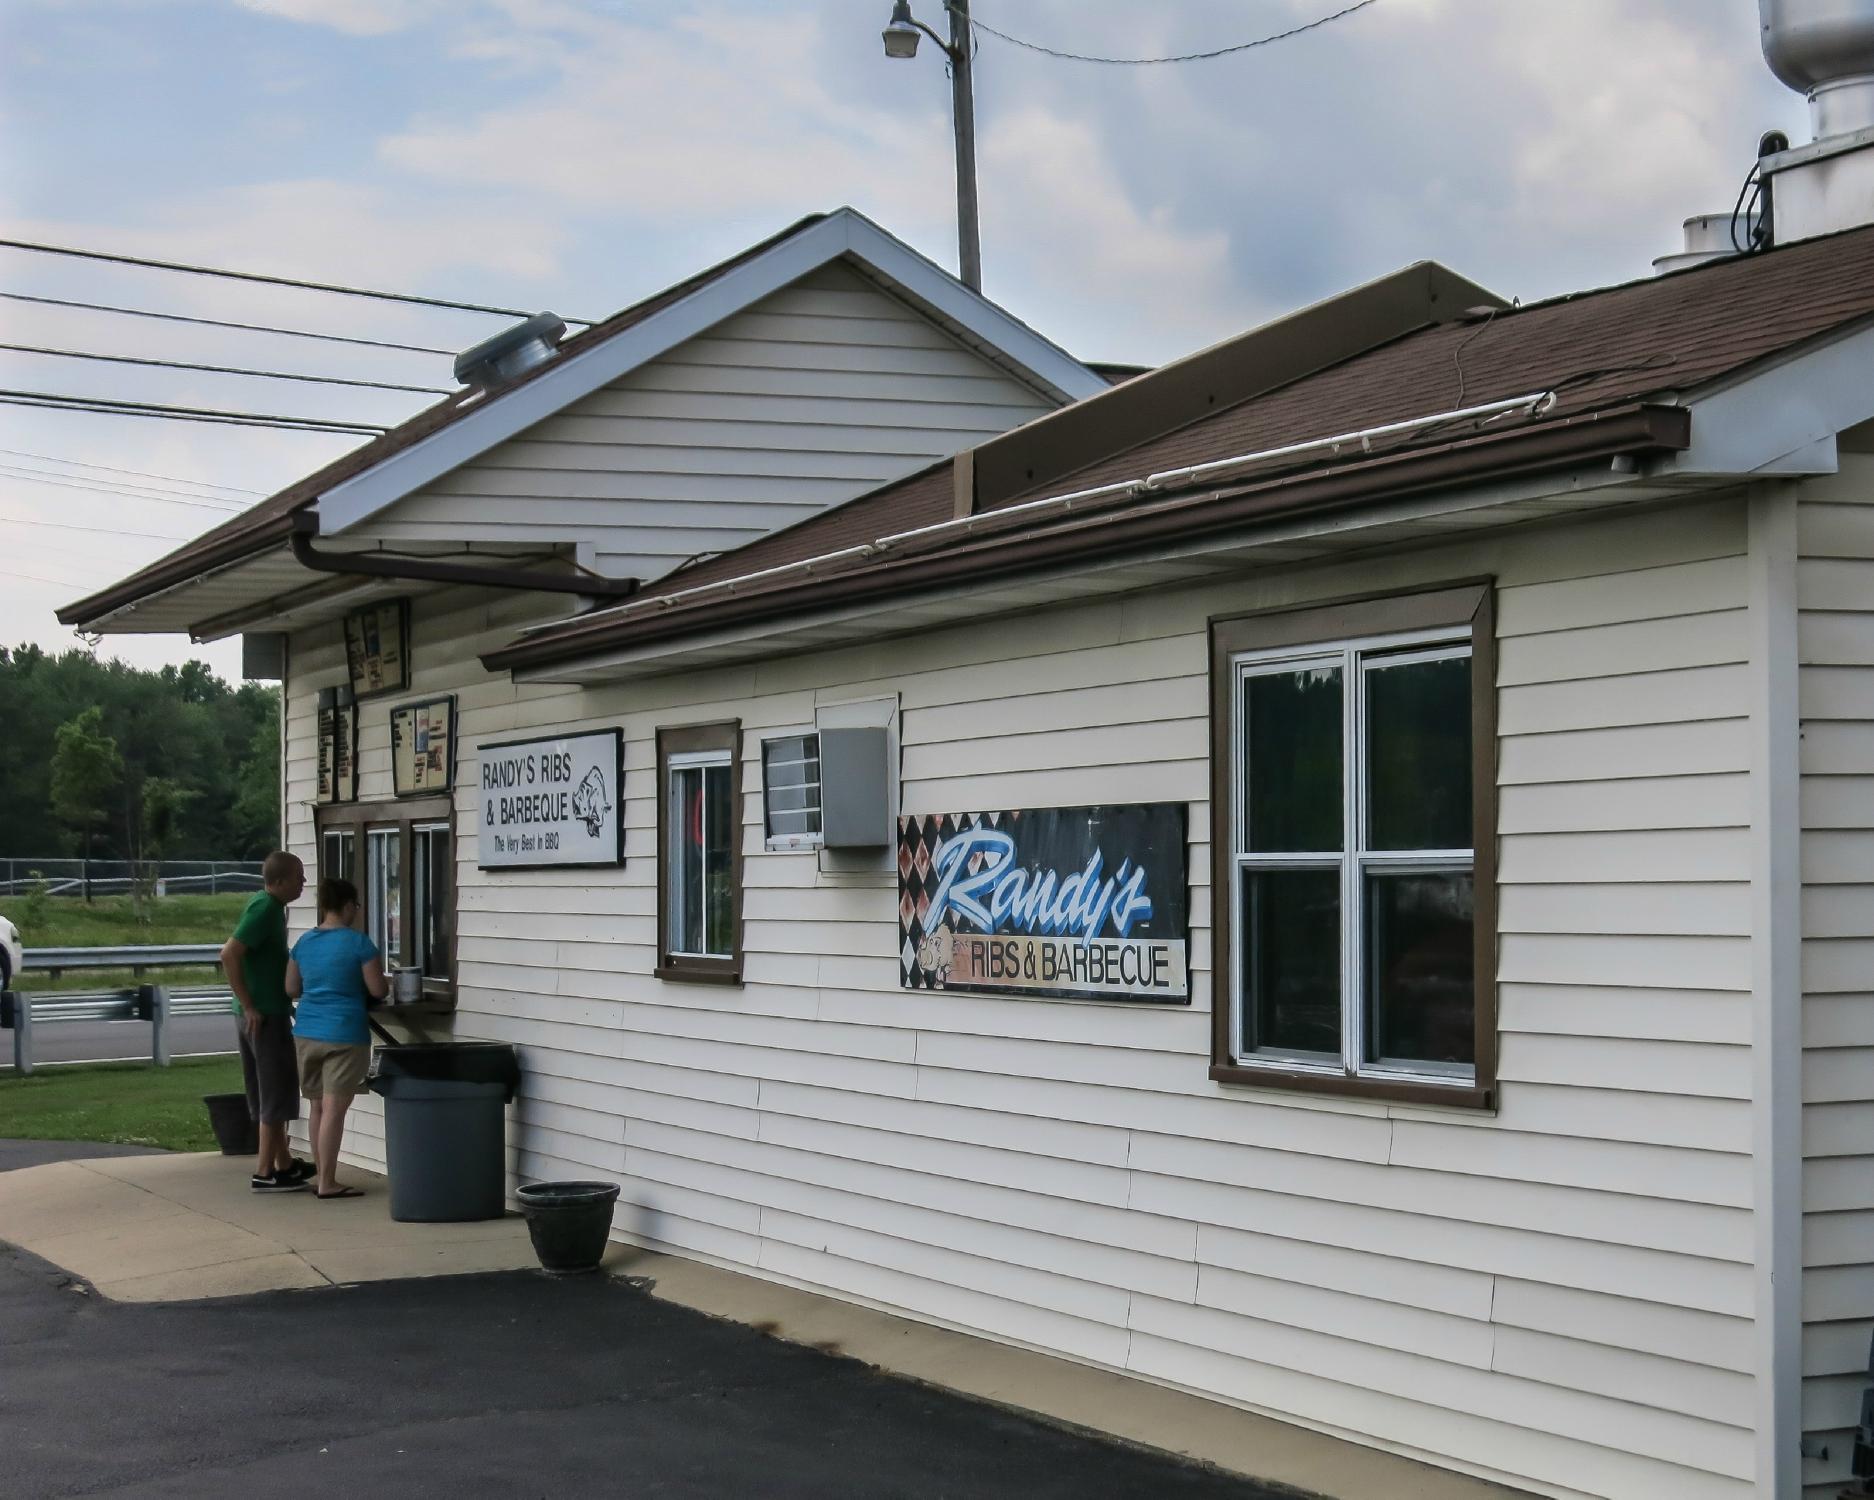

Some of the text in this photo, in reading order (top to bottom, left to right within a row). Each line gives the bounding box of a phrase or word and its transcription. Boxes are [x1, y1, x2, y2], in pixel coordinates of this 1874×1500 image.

[483, 753, 571, 789] RANDY'S RIBS
[486, 793, 568, 825] & BARBEQUE
[495, 835, 504, 851] The
[507, 833, 518, 854] Very
[522, 834, 535, 850] Best
[545, 832, 559, 849] BBQ
[921, 820, 1152, 948] Randy's
[971, 941, 1169, 987] RIBS & BARBECUE
